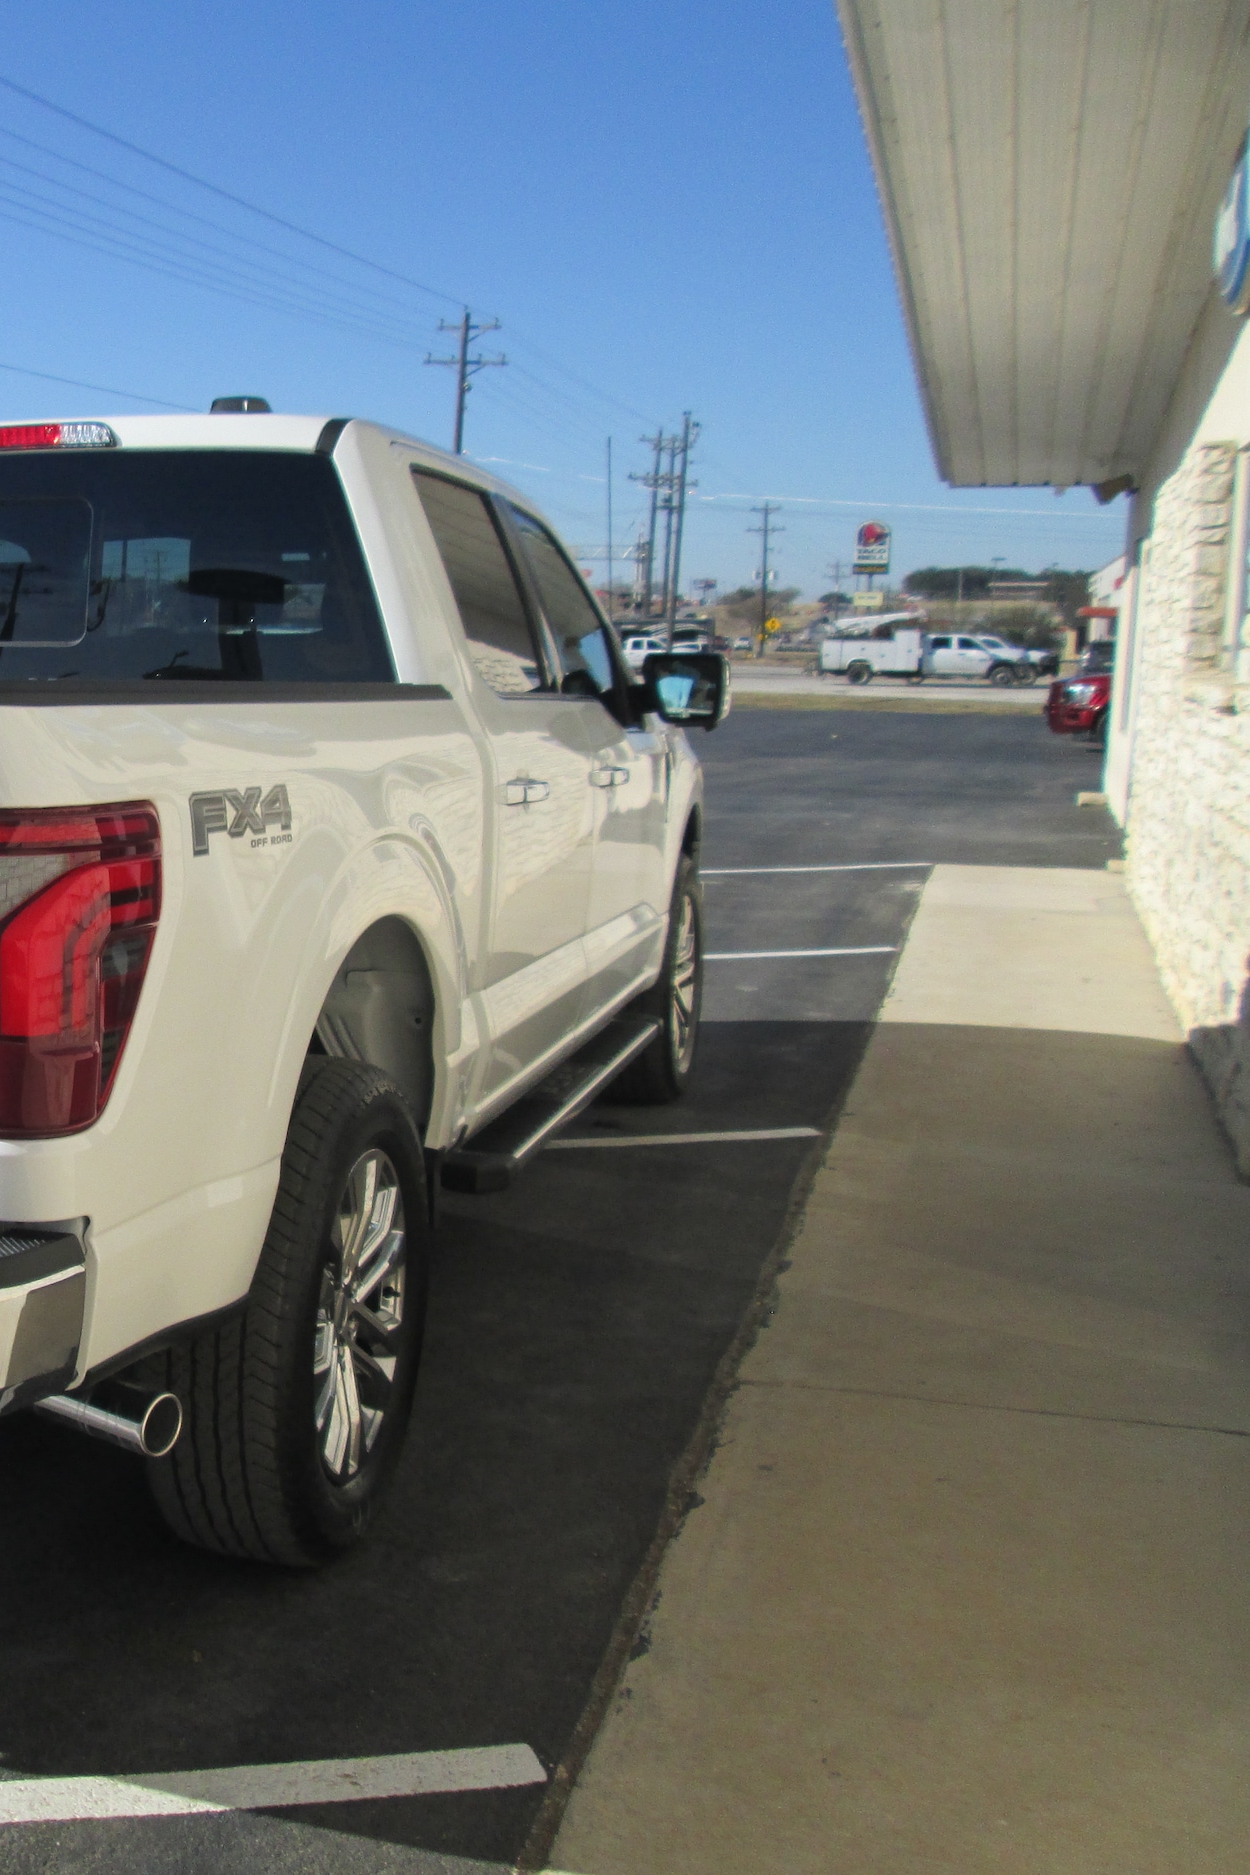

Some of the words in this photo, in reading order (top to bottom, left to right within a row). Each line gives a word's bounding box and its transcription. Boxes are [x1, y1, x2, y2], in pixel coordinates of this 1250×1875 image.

[188, 783, 293, 858] FX4
[250, 837, 268, 849] OFF
[270, 833, 293, 846] ROAD
